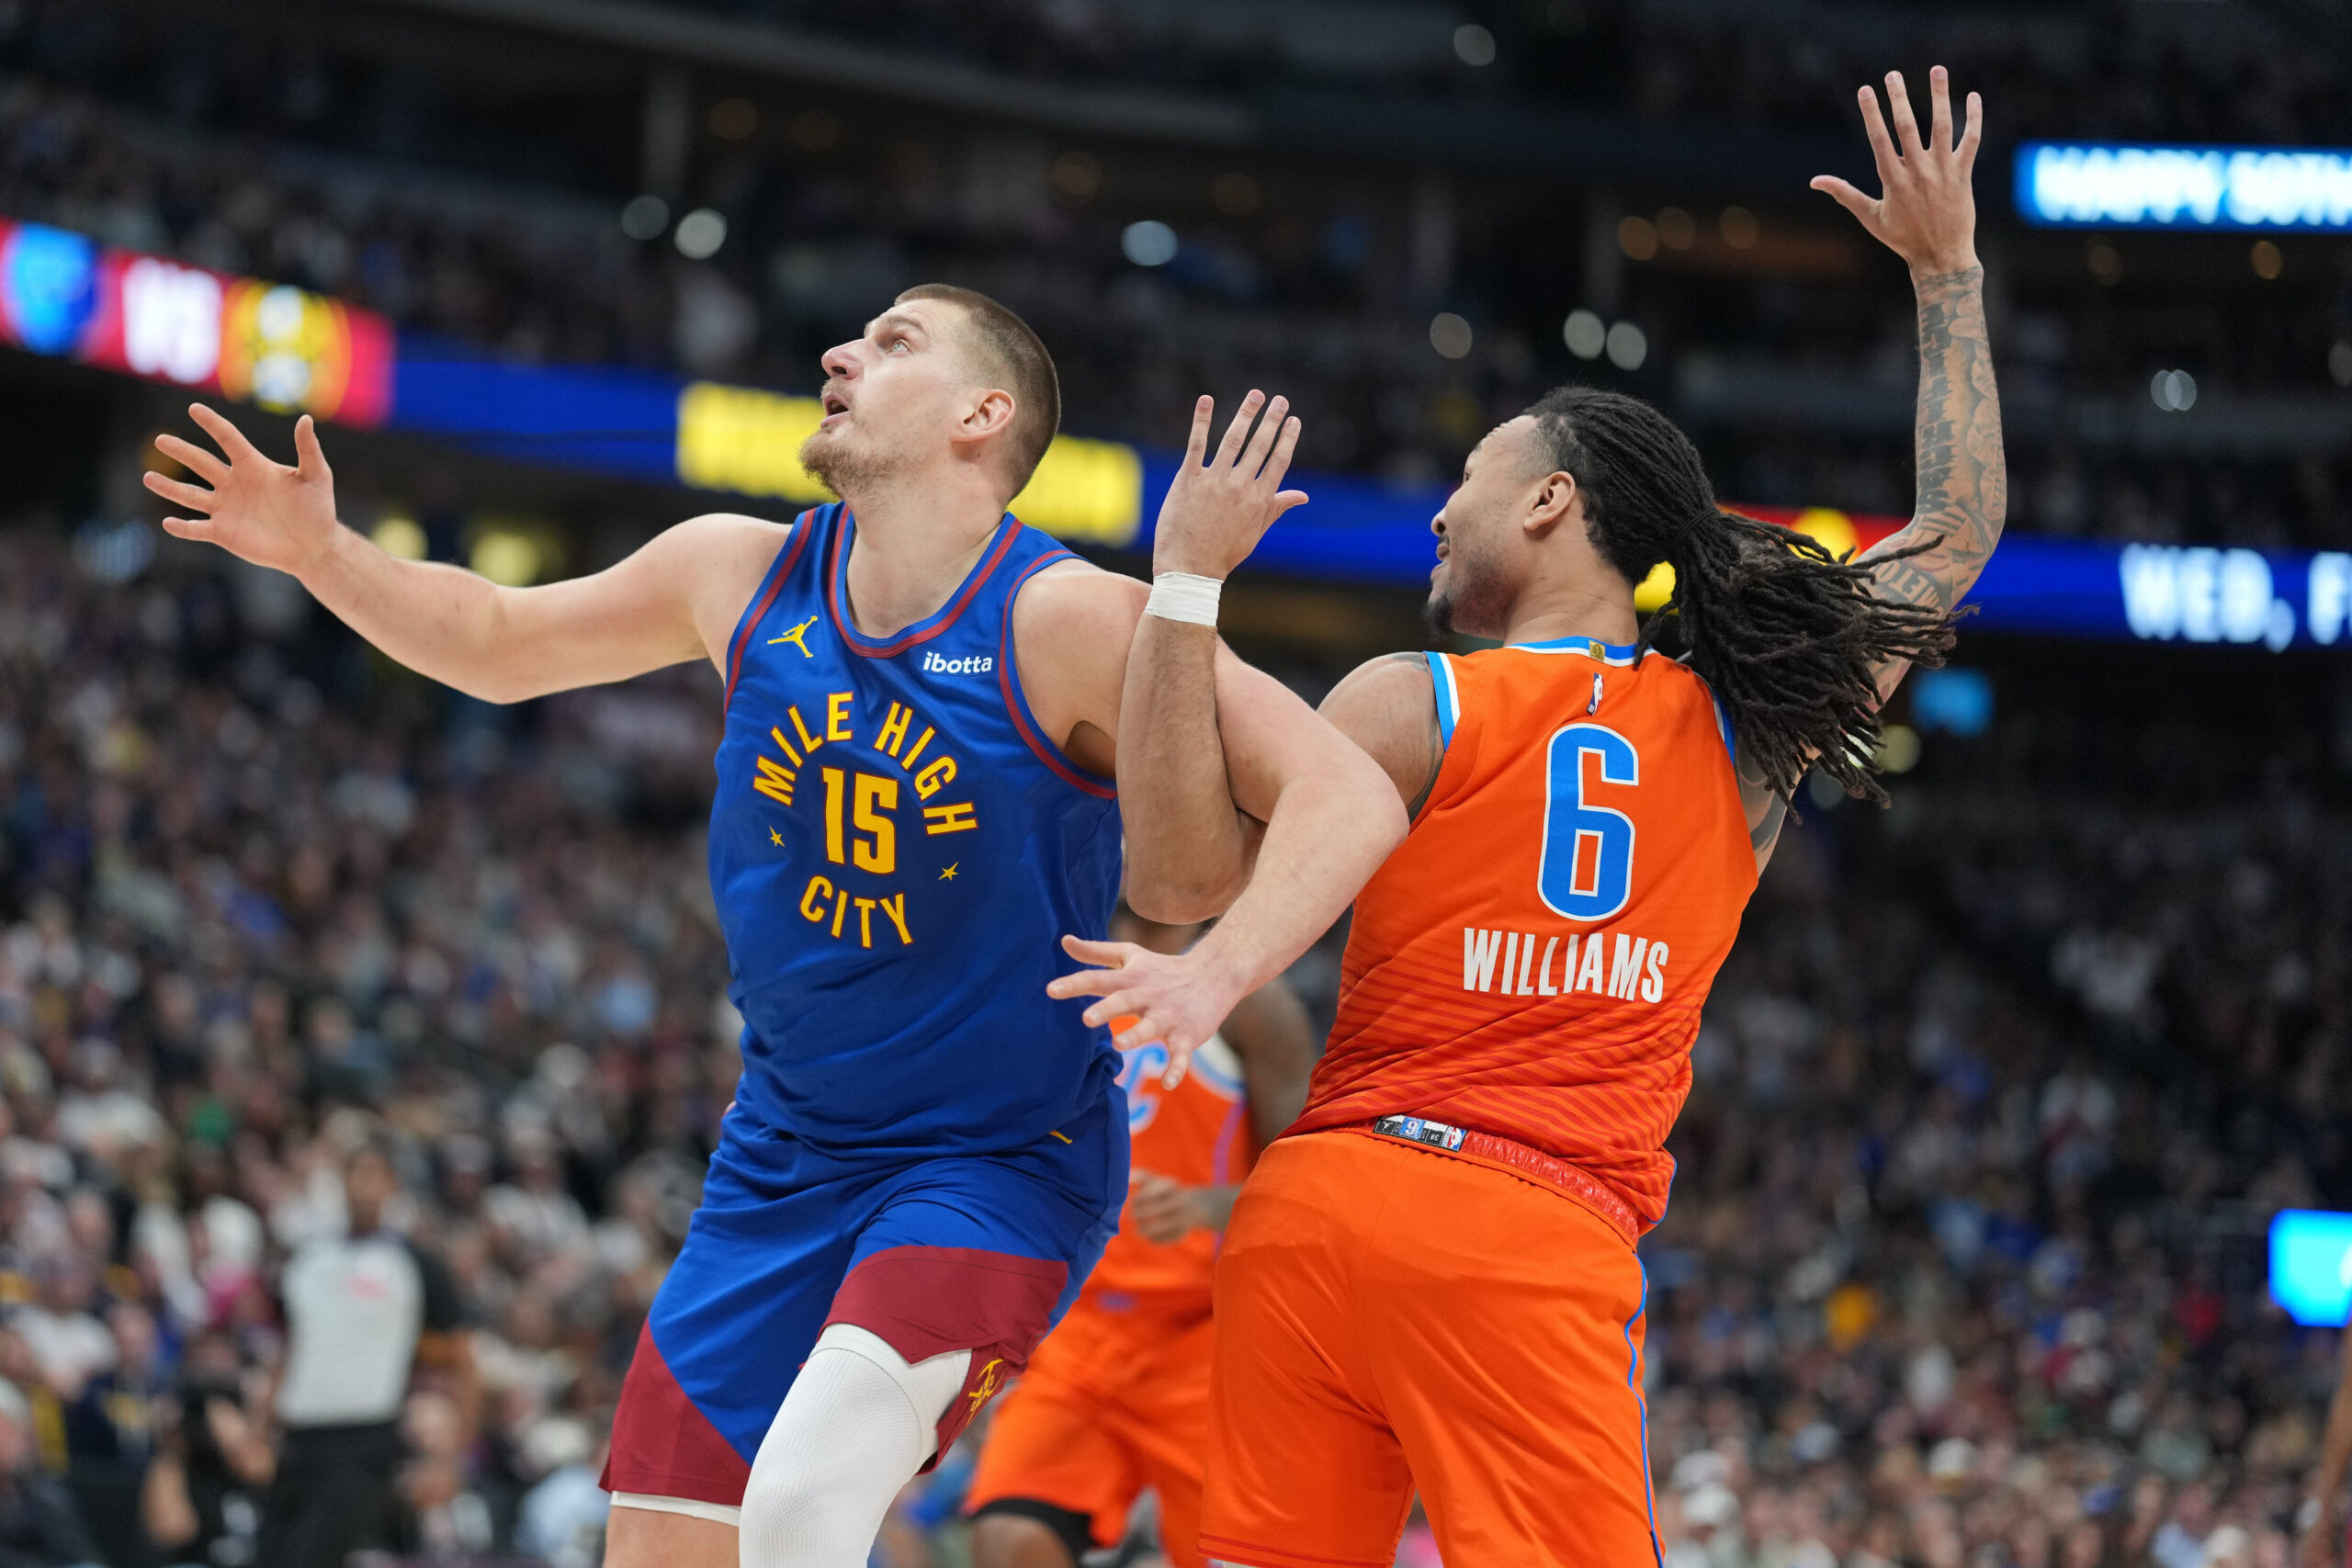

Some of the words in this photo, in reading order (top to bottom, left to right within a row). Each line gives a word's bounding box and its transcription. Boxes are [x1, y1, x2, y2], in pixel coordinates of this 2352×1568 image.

[922, 651, 992, 674] ibotta
[752, 691, 854, 807] MILE
[874, 700, 979, 837] HIGH
[820, 764, 899, 875] 15
[1536, 721, 1640, 922] 6
[798, 874, 915, 950] CITY
[1463, 927, 1669, 1004] WILLIAMS
